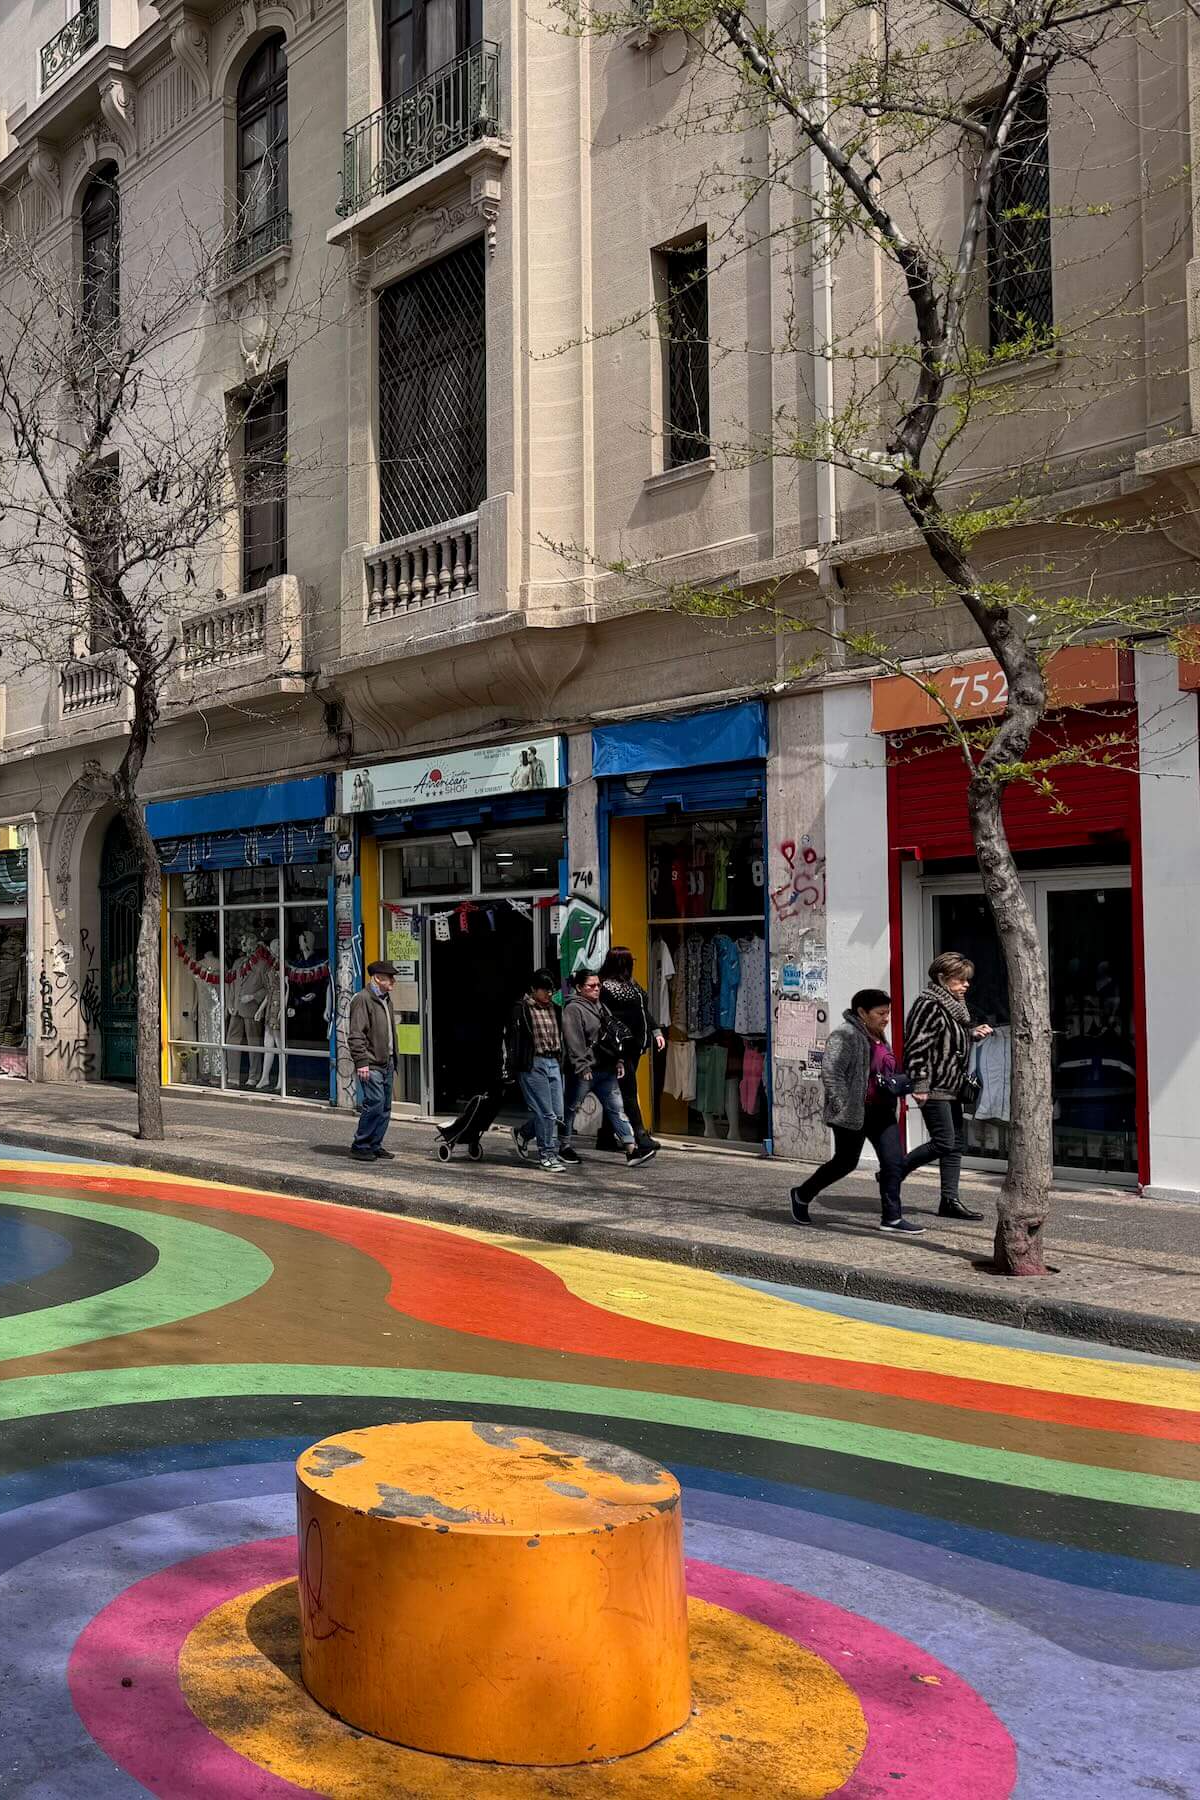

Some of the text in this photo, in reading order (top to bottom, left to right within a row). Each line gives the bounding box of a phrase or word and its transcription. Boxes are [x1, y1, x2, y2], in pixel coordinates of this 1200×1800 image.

[950, 671, 1009, 708] 752
[412, 771, 469, 793] American
[445, 784, 468, 794] SHOP
[573, 871, 593, 889] 740
